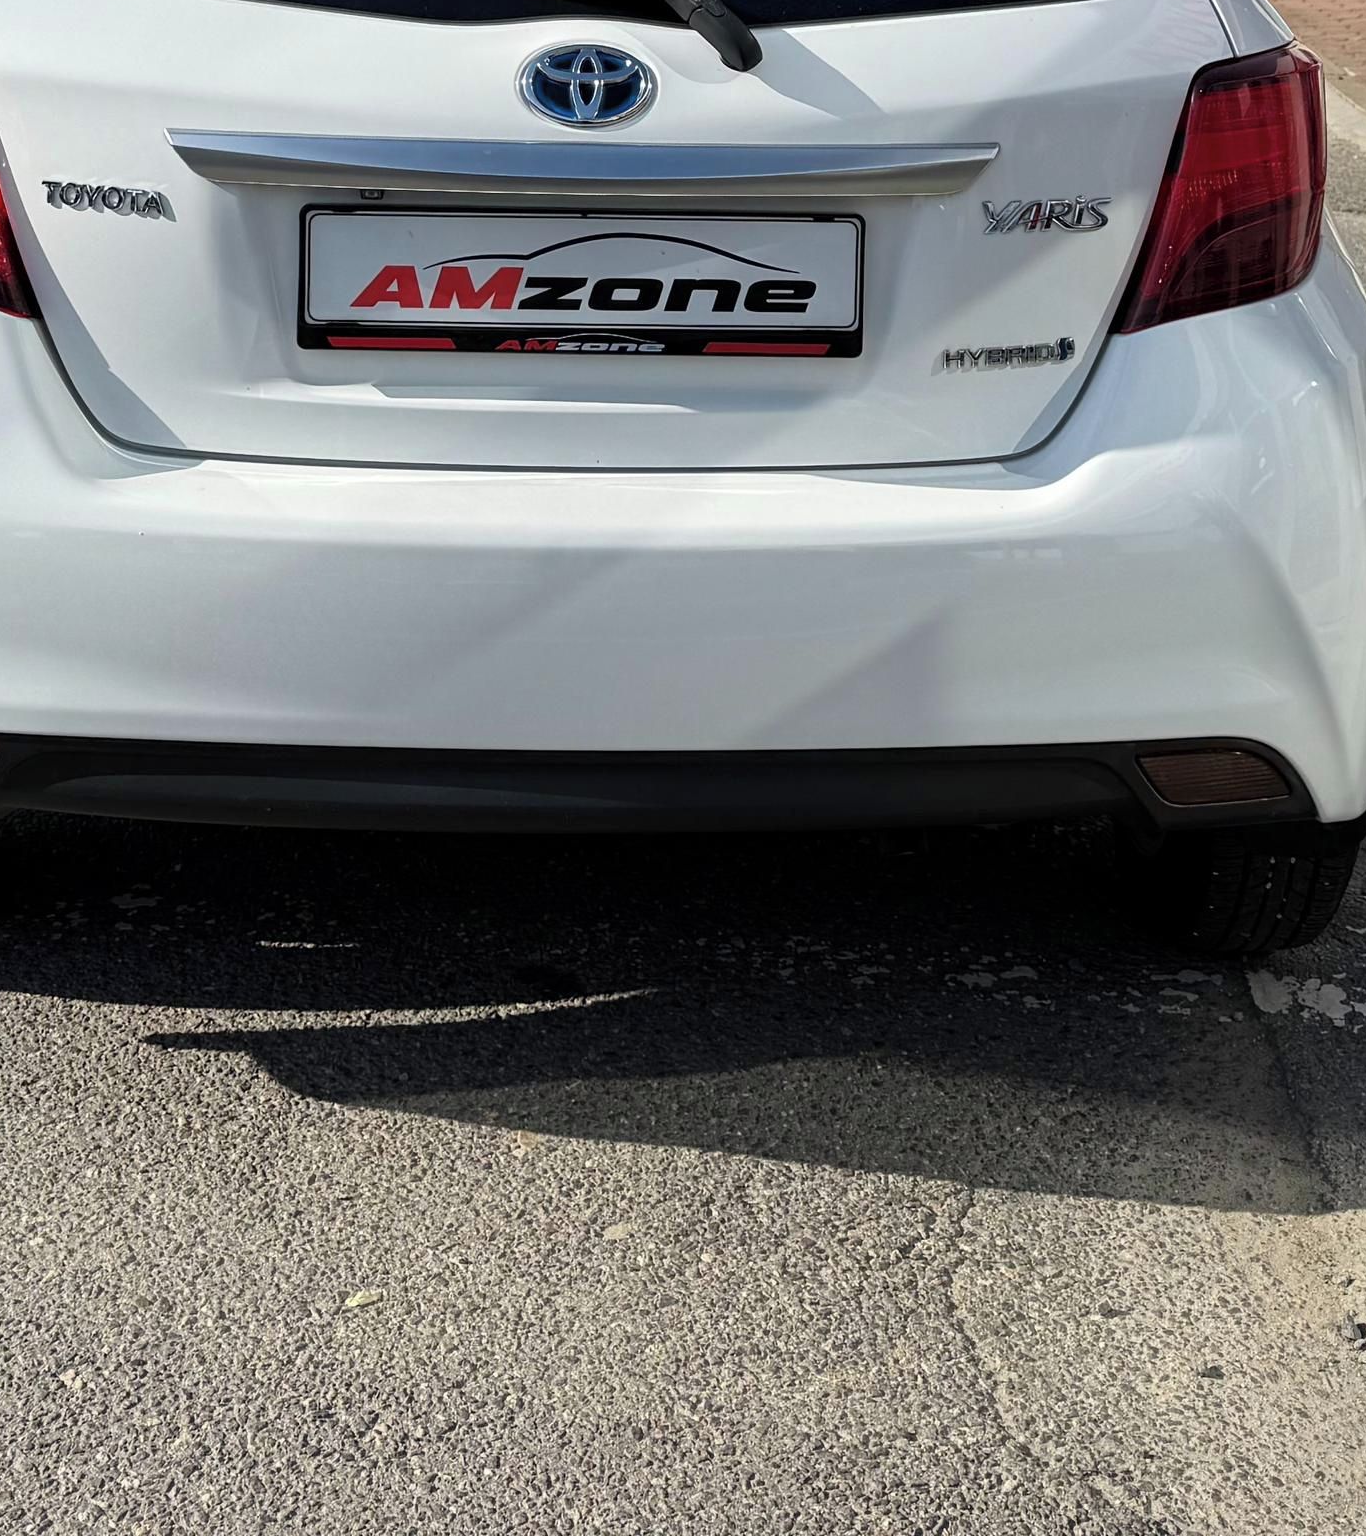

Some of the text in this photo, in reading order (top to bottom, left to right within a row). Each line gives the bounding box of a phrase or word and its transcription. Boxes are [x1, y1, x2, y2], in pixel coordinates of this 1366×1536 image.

[41, 180, 164, 214] TOYOTA
[349, 265, 817, 313] AMzone
[494, 339, 666, 352] AMzone
[942, 344, 1055, 368] HYBRID
